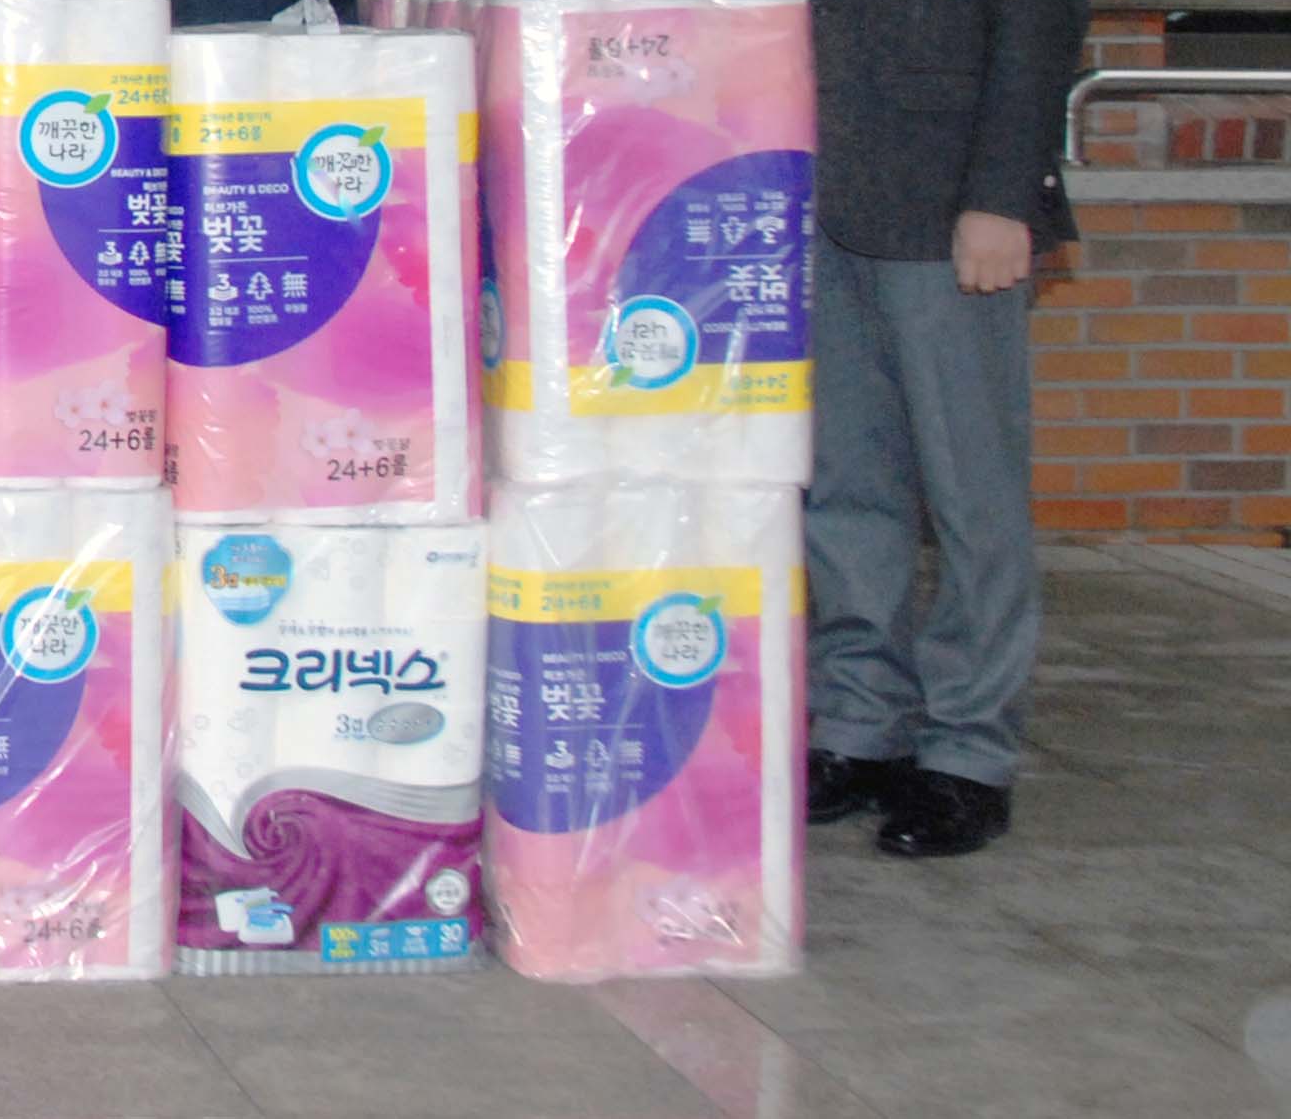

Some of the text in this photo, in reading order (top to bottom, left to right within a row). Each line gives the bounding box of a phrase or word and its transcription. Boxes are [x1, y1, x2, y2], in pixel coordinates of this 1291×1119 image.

[39, 118, 97, 140] 깨끗한
[48, 143, 88, 161] 나라
[203, 215, 267, 253] 벚꽃
[327, 456, 408, 481] 24+6롤
[239, 648, 446, 695] 크리넥스
